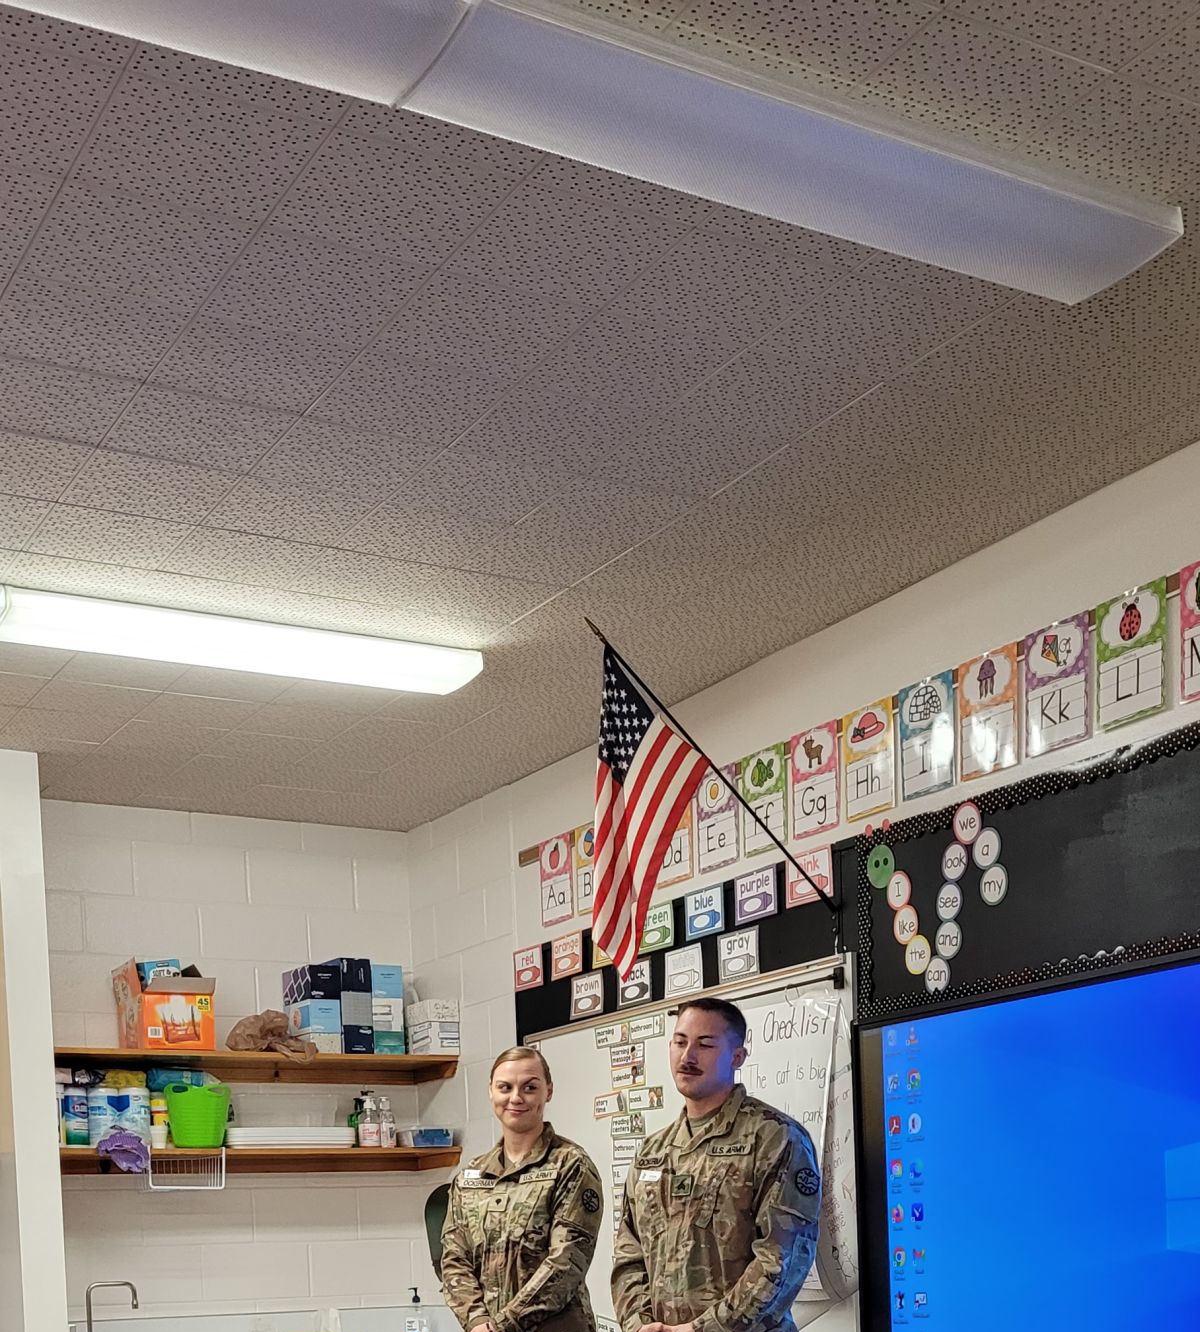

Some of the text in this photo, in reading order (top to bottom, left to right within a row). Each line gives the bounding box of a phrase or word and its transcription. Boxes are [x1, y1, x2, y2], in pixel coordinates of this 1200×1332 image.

[1115, 658, 1140, 702] Ll
[1041, 689, 1070, 729] Kk
[855, 763, 881, 800] Hh
[801, 785, 828, 825] Gg
[753, 801, 776, 837] Ff
[958, 815, 977, 831] we
[706, 823, 727, 853] Ee
[981, 844, 990, 857] a
[944, 853, 966, 869] look
[740, 873, 770, 897] purple
[895, 882, 902, 898] I
[983, 878, 1004, 894] my
[545, 884, 567, 911] Aa
[693, 895, 714, 911] blue
[939, 896, 959, 908] see
[899, 918, 916, 936] like
[554, 939, 579, 955] orange
[726, 935, 750, 955] gray
[938, 933, 960, 948] and
[521, 952, 534, 966] red
[909, 948, 926, 962] the
[927, 968, 946, 983] can
[575, 978, 600, 994] brown
[197, 998, 209, 1006] 45
[762, 1004, 831, 1044] Checklist
[746, 1057, 828, 1090] The cat is big
